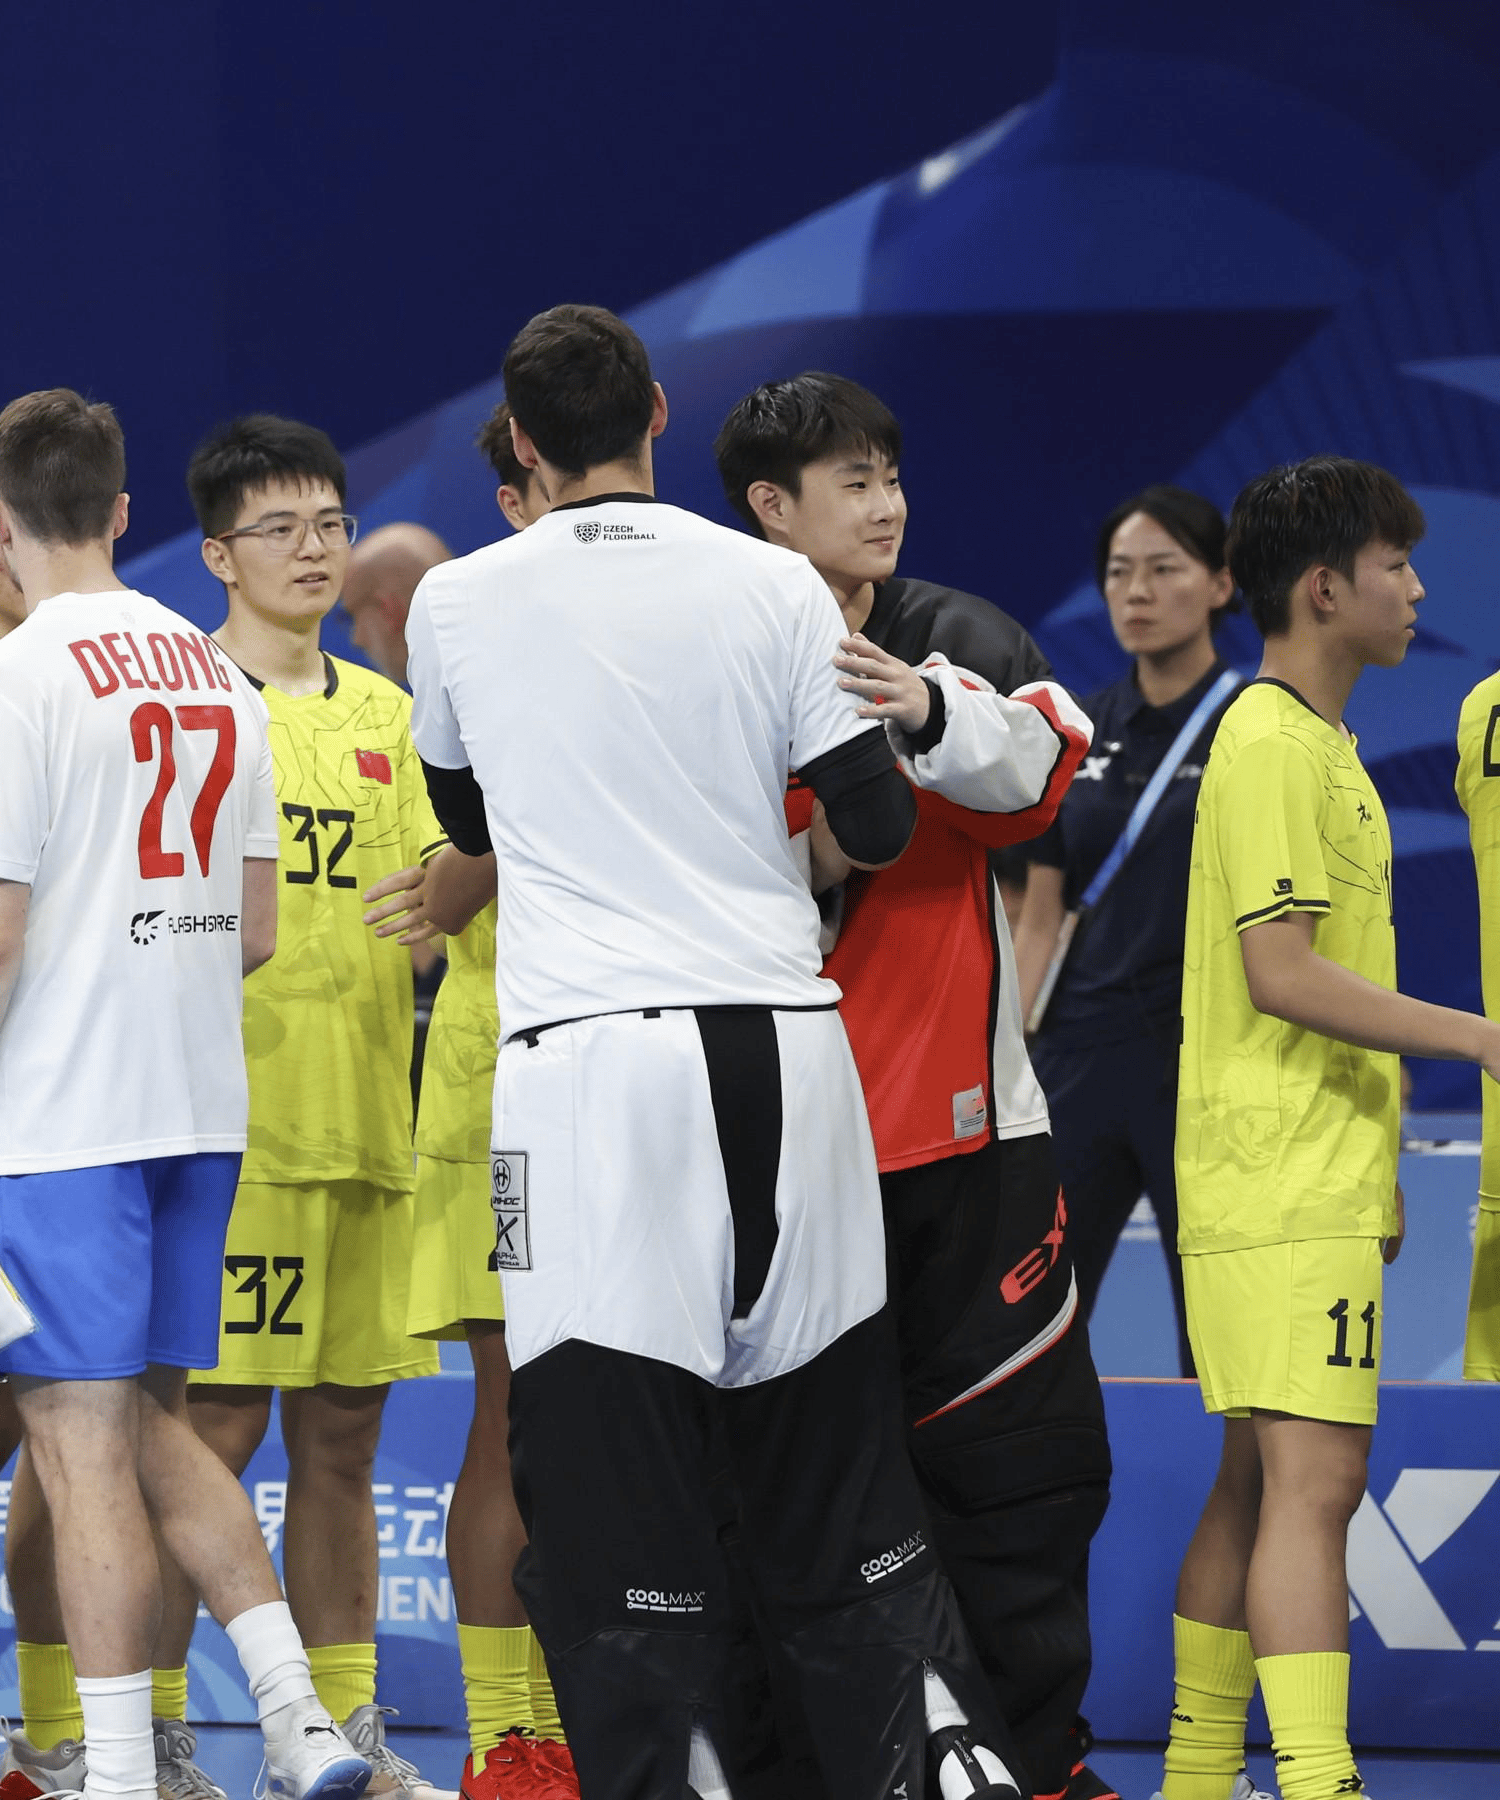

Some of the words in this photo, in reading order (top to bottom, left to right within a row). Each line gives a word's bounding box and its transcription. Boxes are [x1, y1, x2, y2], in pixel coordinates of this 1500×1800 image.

[603, 525, 634, 533] CZECH
[603, 533, 657, 541] FLOORBALL
[67, 631, 233, 699] DELONG
[130, 702, 237, 880] 27
[281, 801, 358, 889] 32
[224, 1255, 304, 1336] 32
[1326, 1298, 1375, 1369] 11
[861, 1531, 924, 1576] COOLMAX
[626, 1588, 705, 1605] COOLMAX
